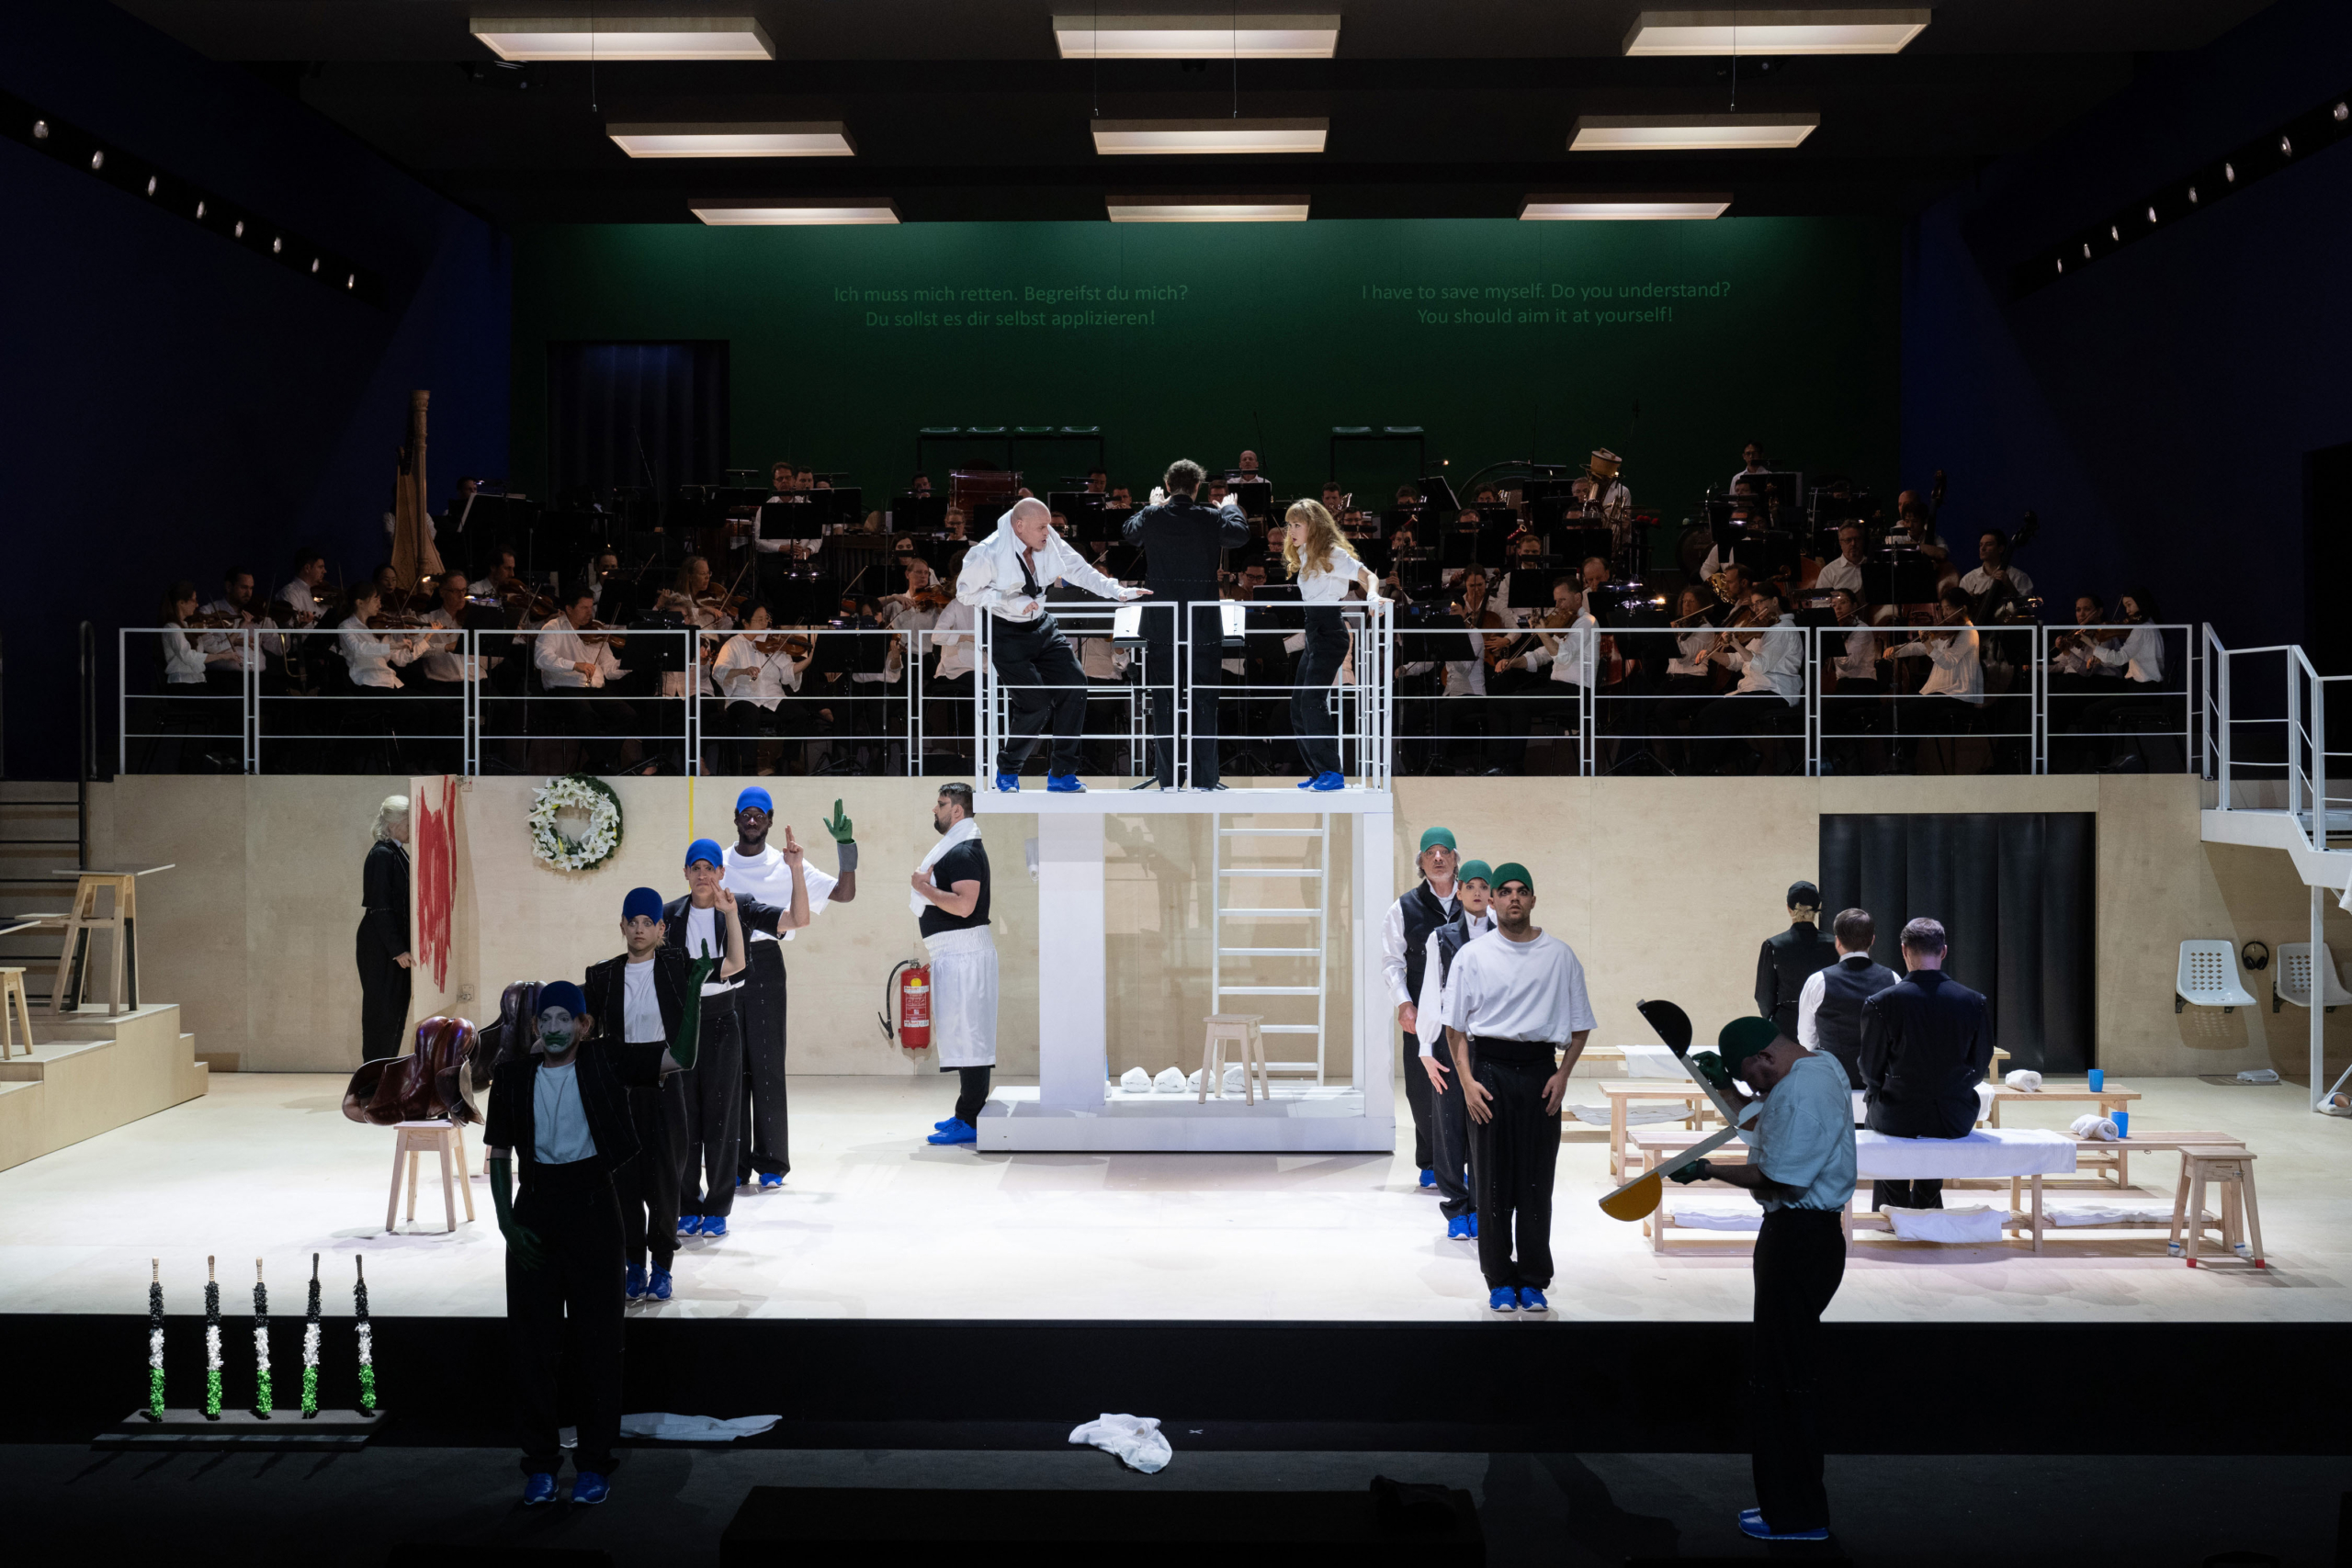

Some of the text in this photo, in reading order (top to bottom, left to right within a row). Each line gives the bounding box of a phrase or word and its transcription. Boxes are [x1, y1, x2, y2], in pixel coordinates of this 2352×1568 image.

[834, 284, 1188, 304] Ich muss mich retten. Begreifst du mich?
[1362, 281, 1731, 303] I have to save myself. Do you understand?
[866, 310, 1155, 329] Du sollst es dir selbst applizieren!
[1418, 307, 1673, 326] You should aim it at yourself!
